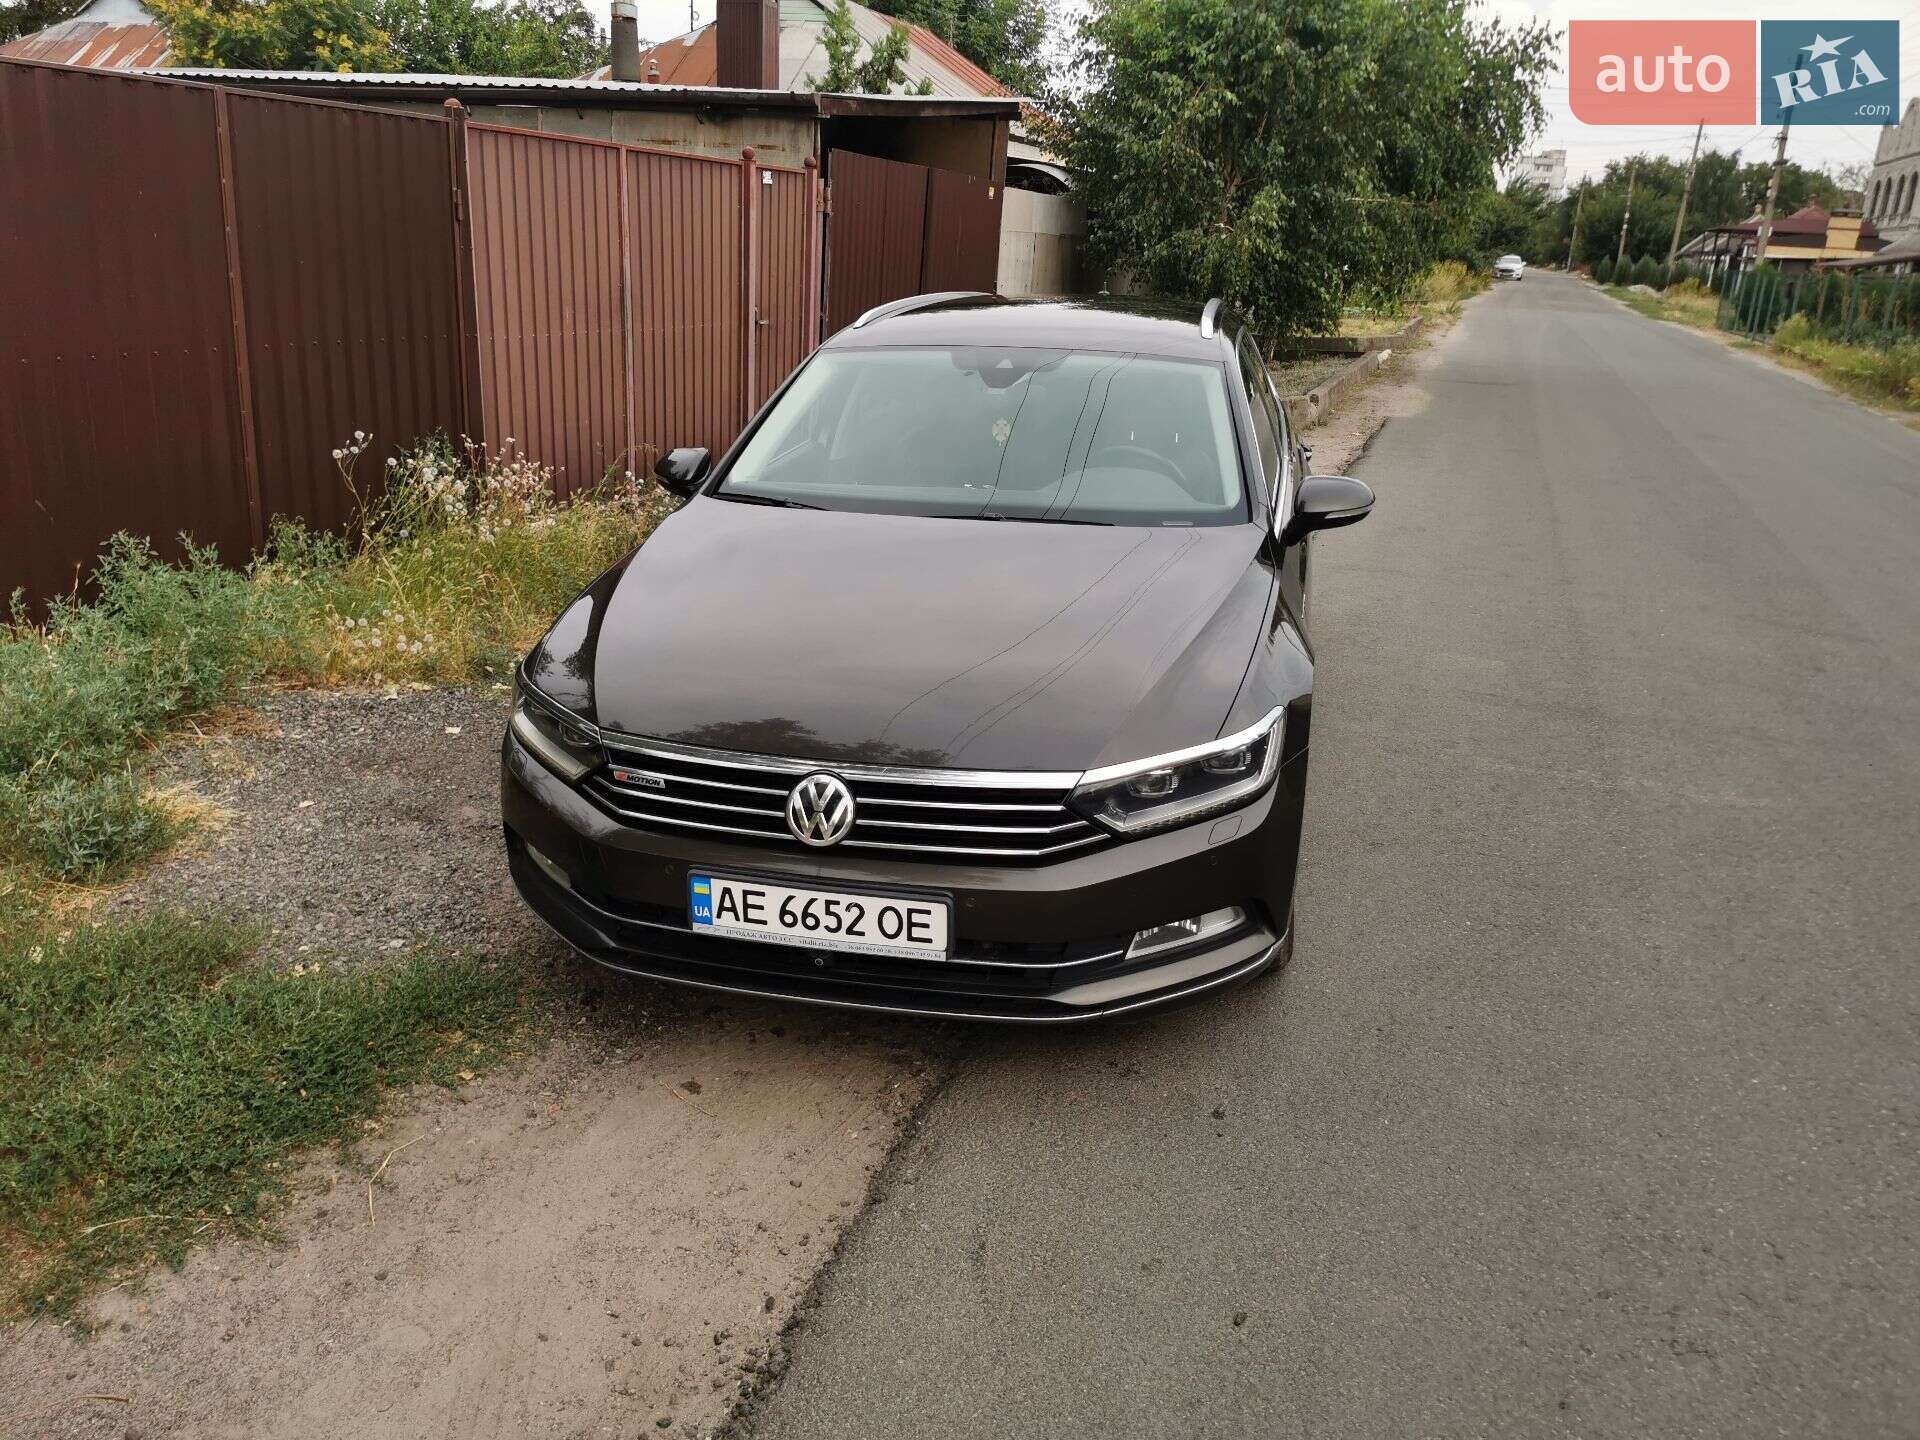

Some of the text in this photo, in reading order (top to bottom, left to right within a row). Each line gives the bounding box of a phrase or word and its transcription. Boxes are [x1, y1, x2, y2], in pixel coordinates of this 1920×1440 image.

[694, 906, 710, 918] UA
[716, 886, 933, 944] AE 6652 OE
